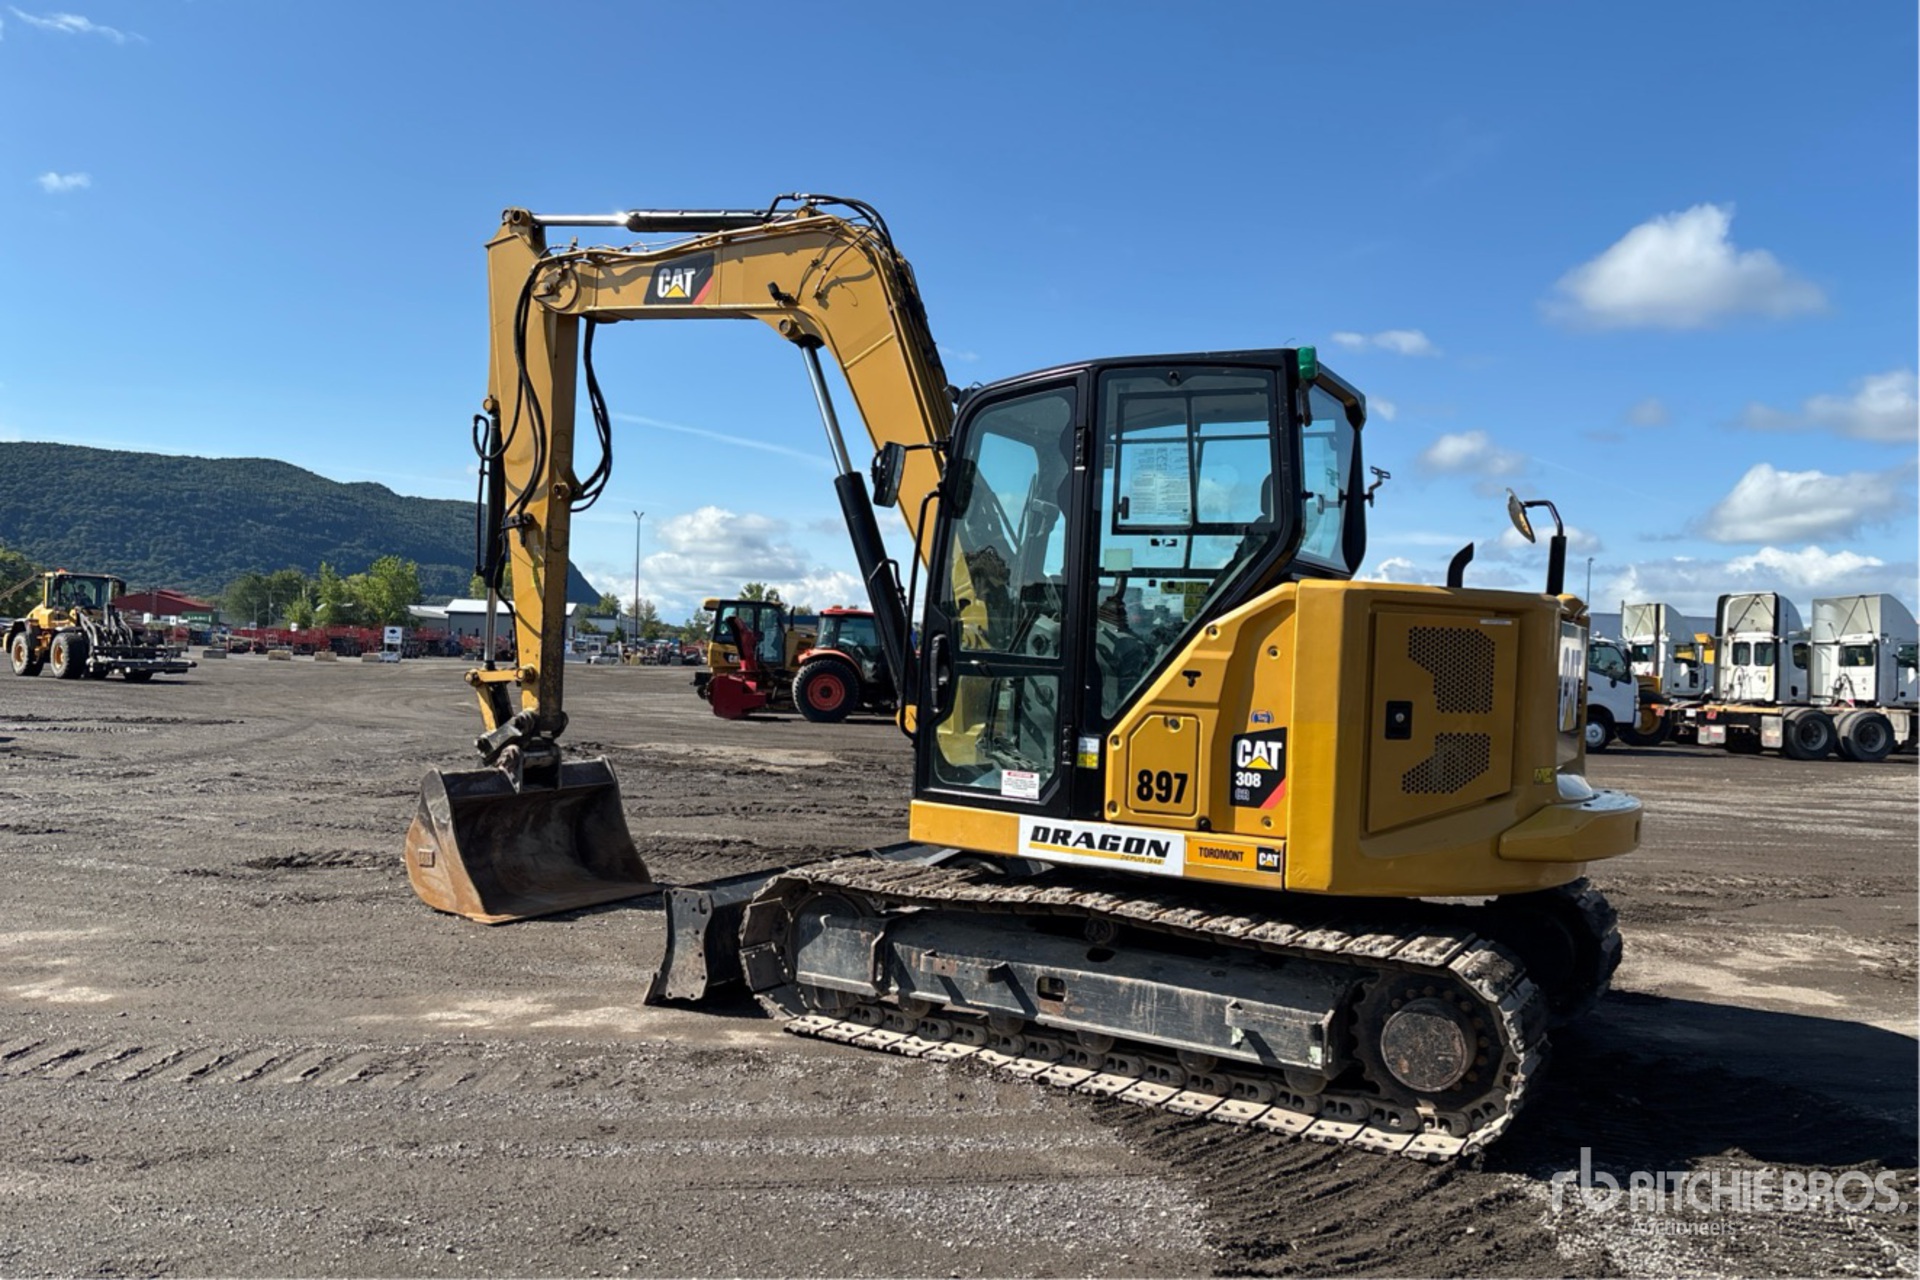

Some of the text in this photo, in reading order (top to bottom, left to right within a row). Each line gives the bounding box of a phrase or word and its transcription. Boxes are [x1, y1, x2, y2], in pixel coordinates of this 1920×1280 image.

[657, 268, 696, 298] CAT
[1236, 738, 1283, 771] CAT
[1136, 769, 1188, 804] 897
[1235, 771, 1262, 788] 308
[1030, 825, 1171, 858] DRAGON
[1198, 846, 1280, 867] TOROMONT CAT
